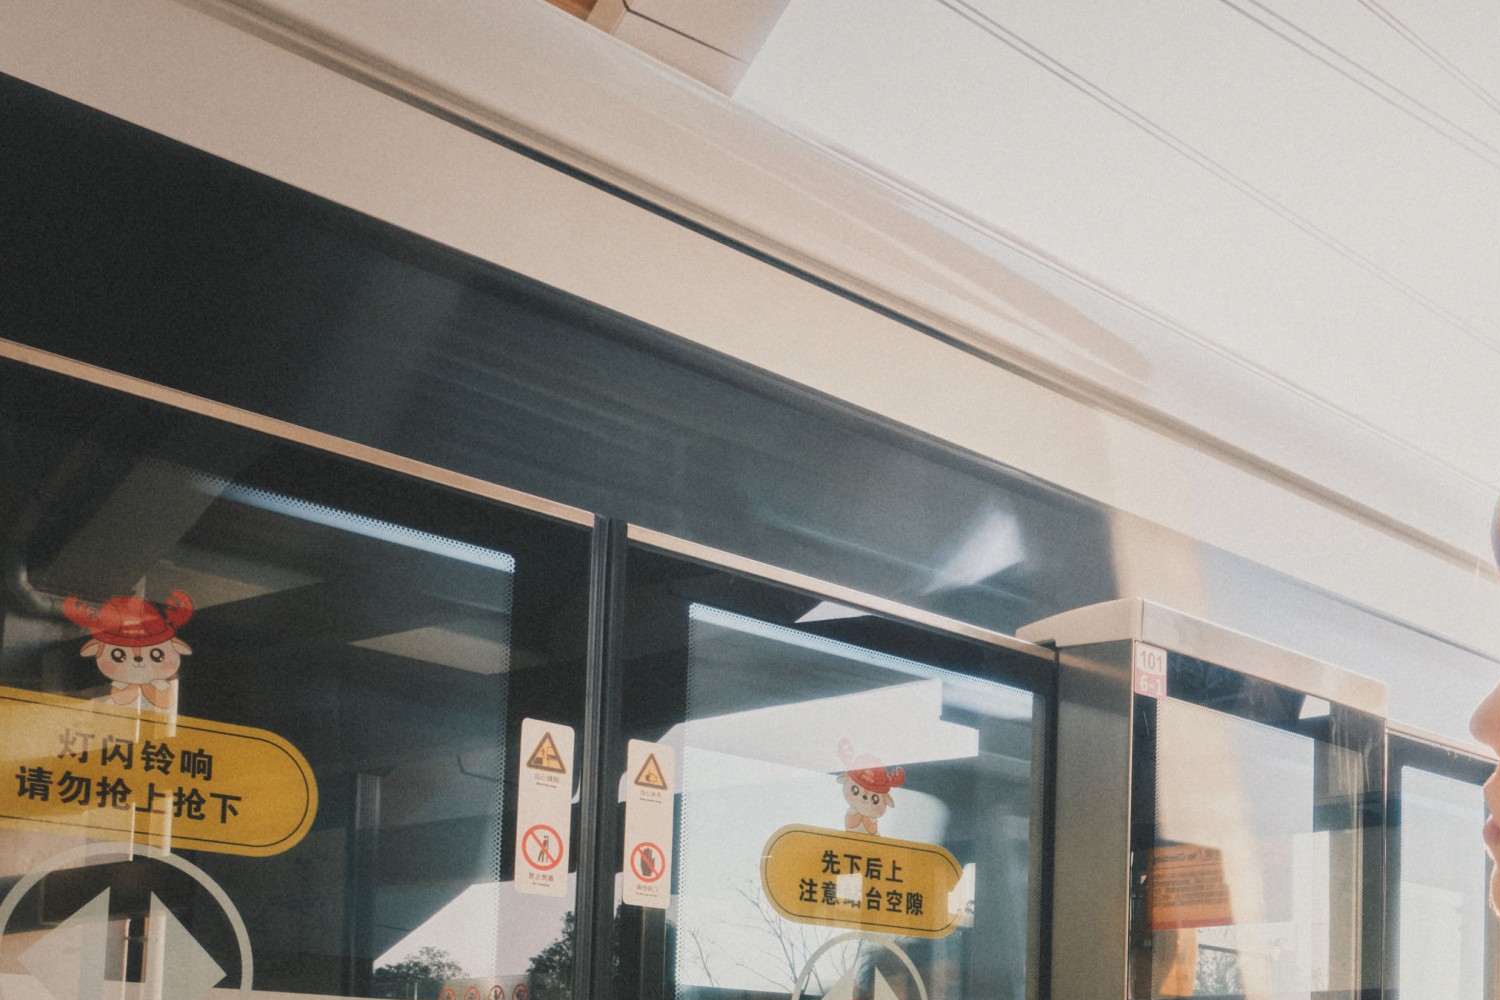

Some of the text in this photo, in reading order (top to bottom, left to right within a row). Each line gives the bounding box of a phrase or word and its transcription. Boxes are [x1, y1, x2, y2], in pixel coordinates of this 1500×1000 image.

[1140, 650, 1162, 672] 101
[1140, 675, 1162, 696] 6-1
[57, 728, 213, 781] 灯闪铃响
[15, 766, 242, 824] 请勿抢上抢下
[821, 850, 903, 883] 先下后上
